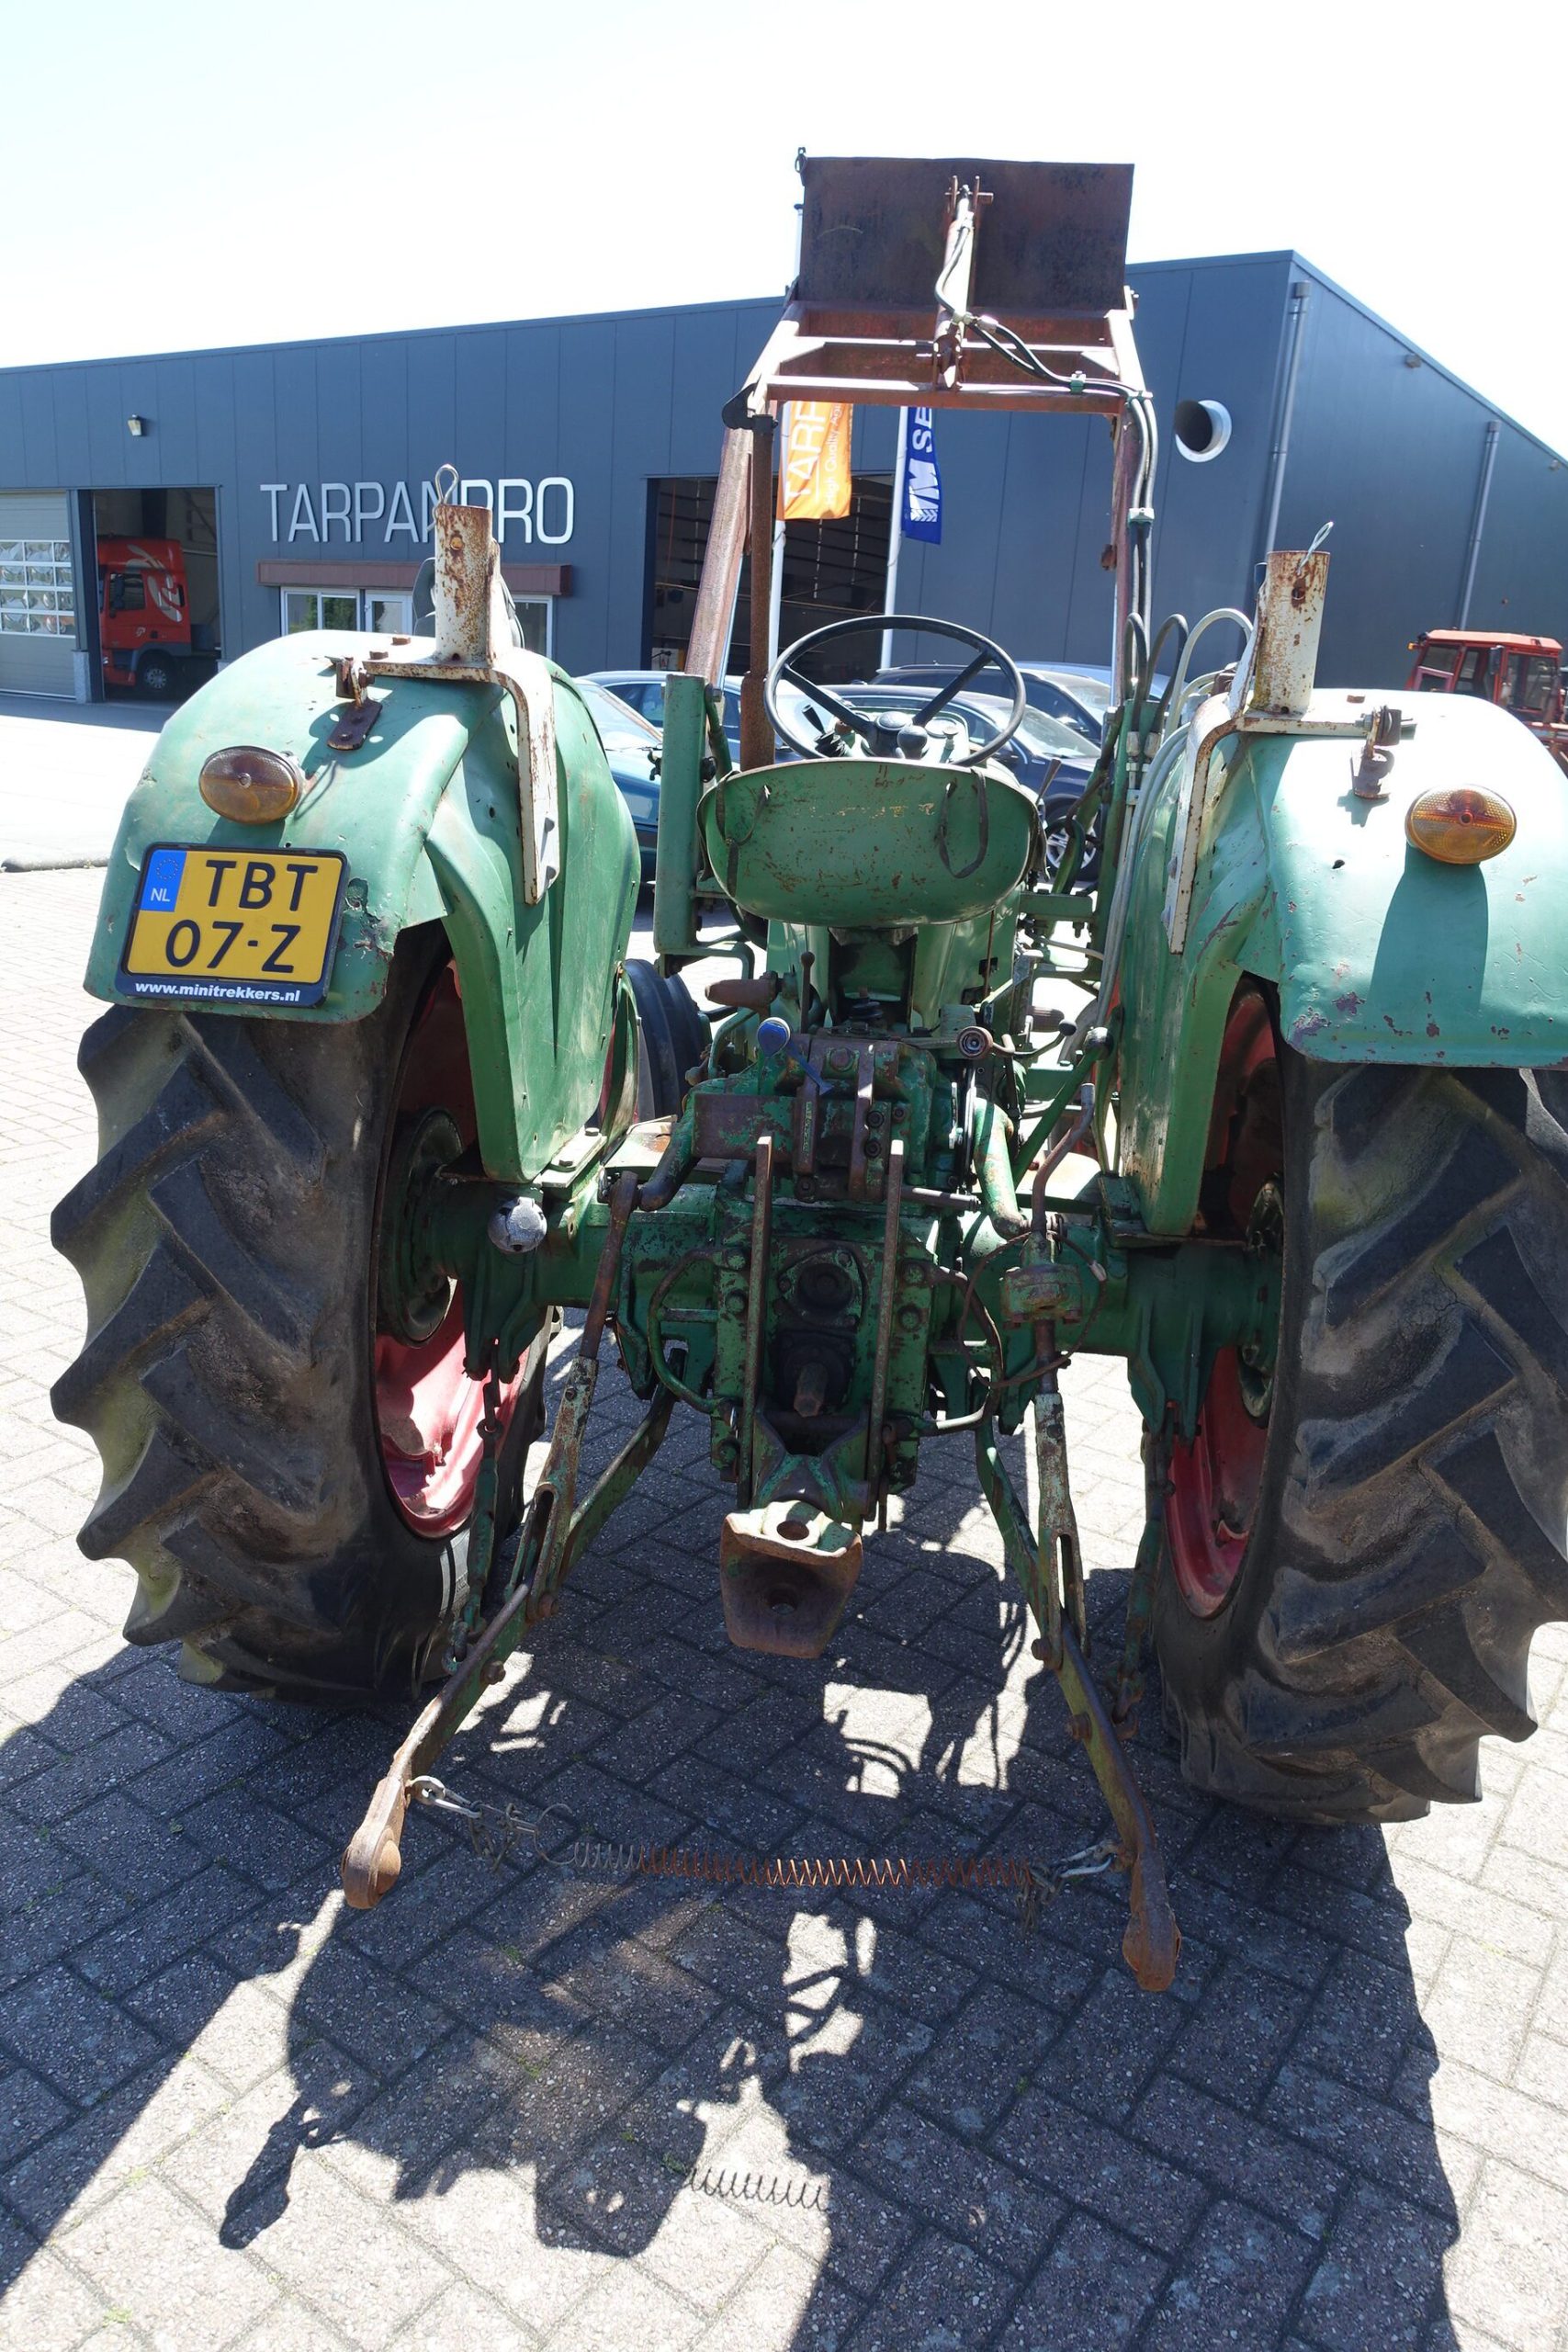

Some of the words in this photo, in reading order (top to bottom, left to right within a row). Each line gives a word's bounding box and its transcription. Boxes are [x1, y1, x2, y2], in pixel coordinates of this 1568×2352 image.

[824, 477, 840, 505] High
[151, 888, 171, 902] NL
[206, 860, 319, 911] TBT
[165, 920, 301, 974] 07-Z
[135, 982, 301, 1002] www.minitrekkers.nl
